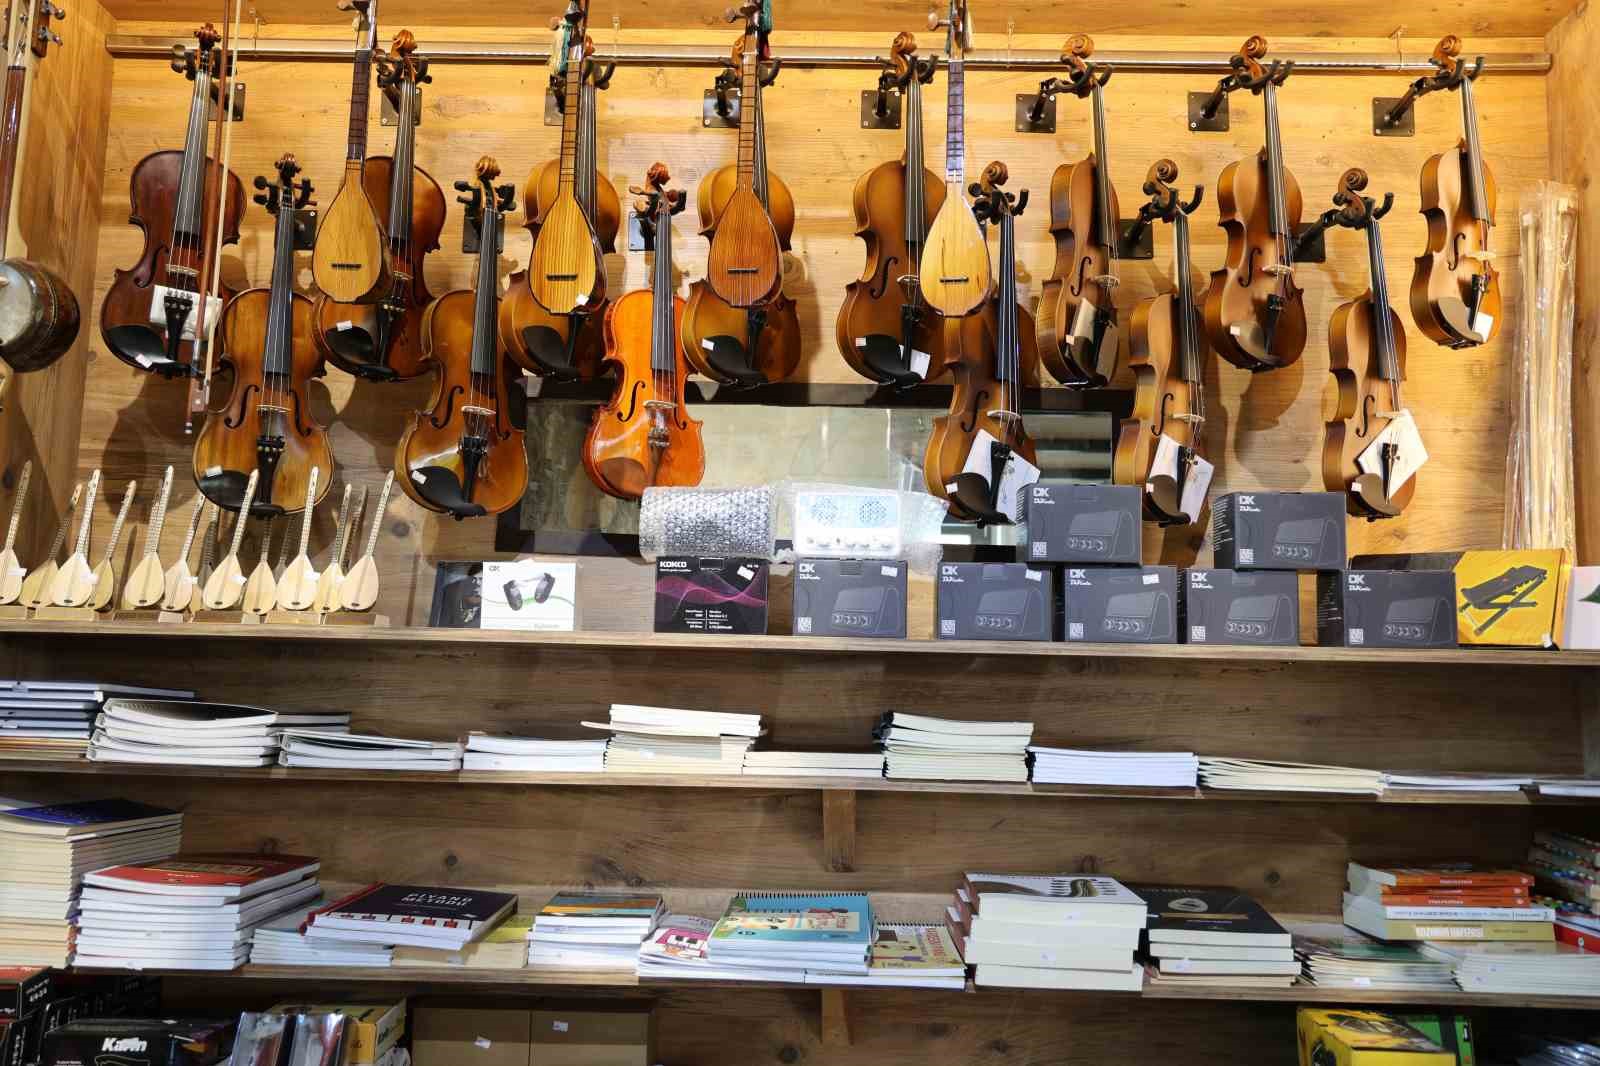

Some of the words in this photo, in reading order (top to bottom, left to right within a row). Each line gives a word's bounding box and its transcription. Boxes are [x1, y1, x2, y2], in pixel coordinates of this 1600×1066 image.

[1033, 487, 1049, 497] DK
[1239, 495, 1255, 505] DK
[799, 563, 815, 573] DK
[942, 565, 958, 576] DK
[1070, 569, 1086, 579] DK
[1191, 572, 1207, 582] DK
[1348, 574, 1365, 584] DK
